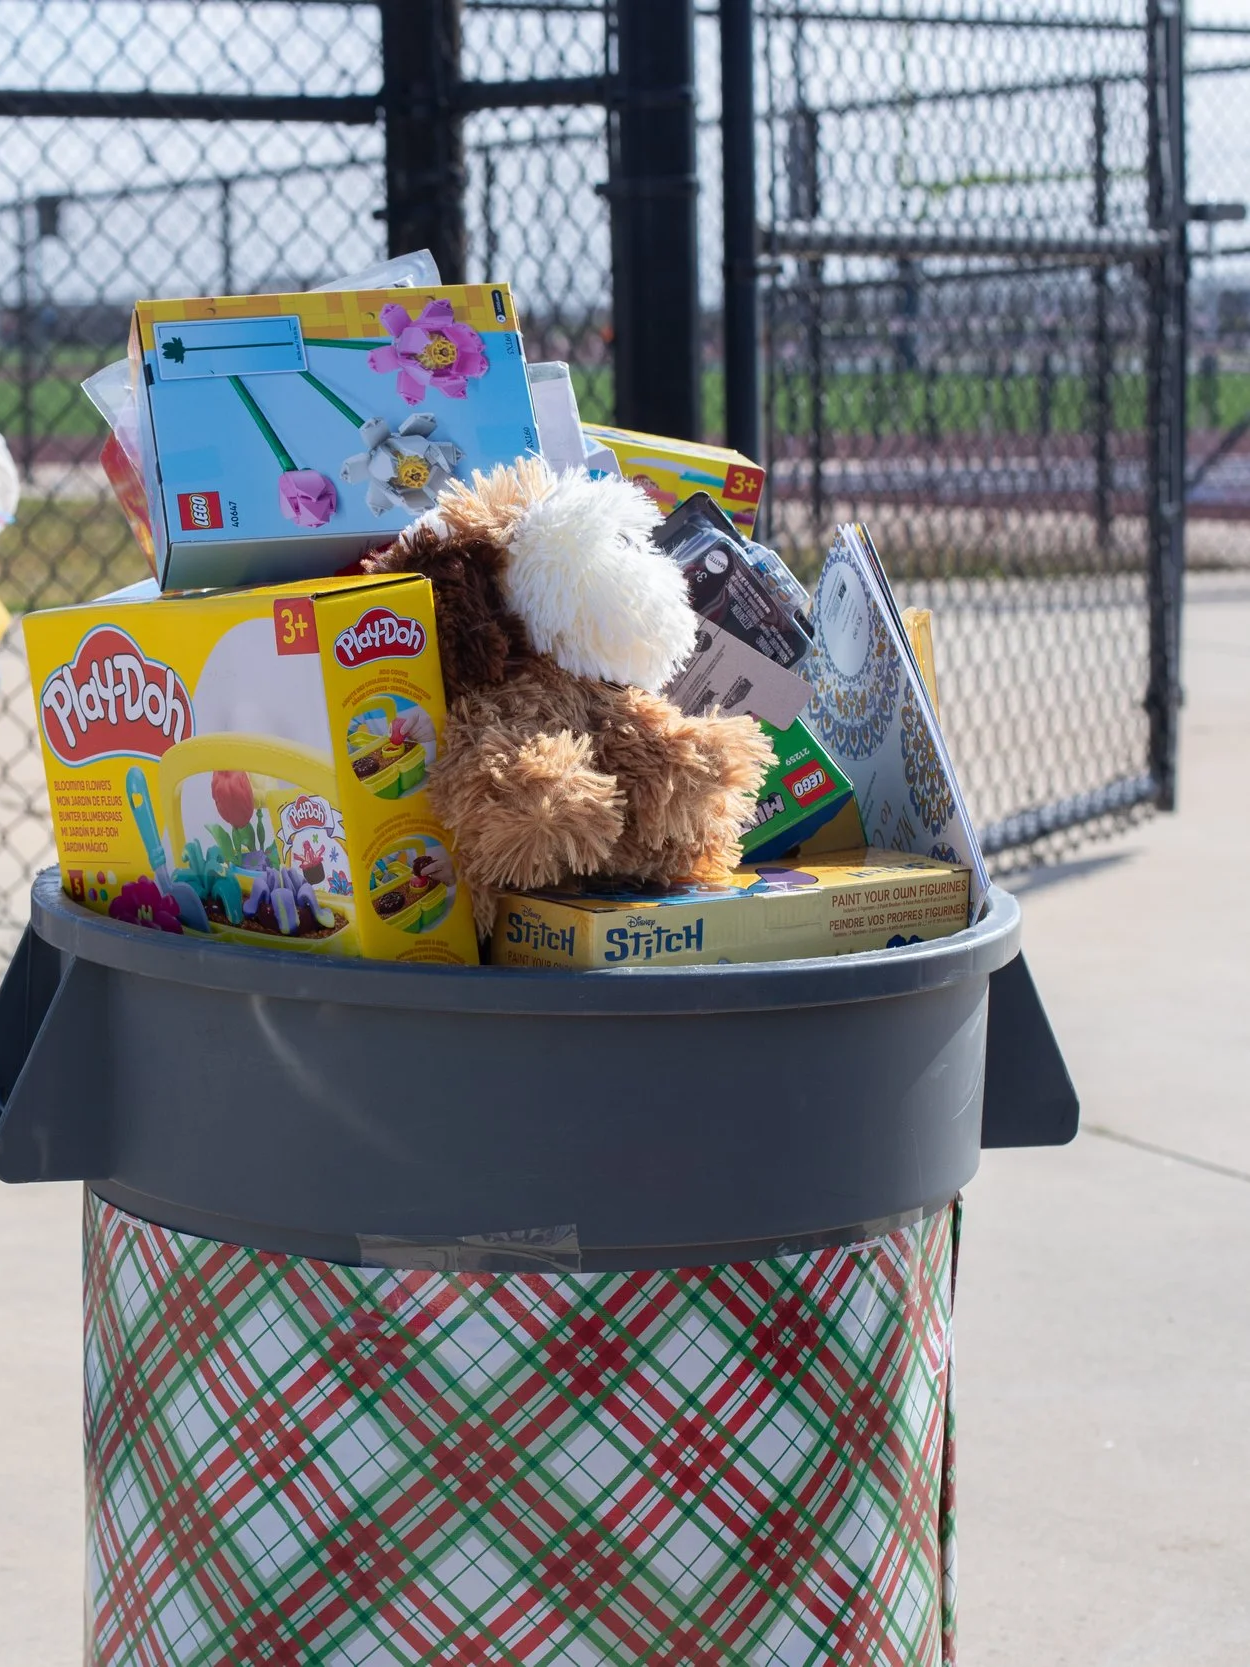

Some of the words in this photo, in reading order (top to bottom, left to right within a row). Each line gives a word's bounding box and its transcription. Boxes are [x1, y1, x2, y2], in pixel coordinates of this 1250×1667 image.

[730, 471, 758, 495] 3+
[190, 495, 210, 527] LEGO
[229, 501, 239, 528] 40647
[706, 553, 726, 570] MATTEL
[695, 569, 708, 583] 3+
[281, 608, 308, 644] 3+
[336, 617, 421, 661] Play-Doh
[42, 653, 185, 748] Play-Doh
[785, 747, 810, 766] 21259
[793, 769, 824, 798] LEGO
[56, 796, 70, 806] MON
[70, 796, 91, 806] JARDIN
[92, 796, 100, 806] DE
[101, 795, 122, 806] FLEURS
[59, 811, 81, 822] BUNTER
[289, 801, 324, 826] Play-Doh
[90, 827, 119, 837] PLAY-DOH
[74, 877, 81, 895] 5
[832, 892, 861, 908] PAINT
[864, 889, 890, 904] YOUR
[893, 886, 916, 900] OWN
[919, 880, 967, 897] FIGURINES
[830, 916, 864, 931] PEINDRE
[867, 914, 885, 926] VOS
[887, 909, 923, 924] PROPRES
[925, 904, 966, 918] FIGURINES
